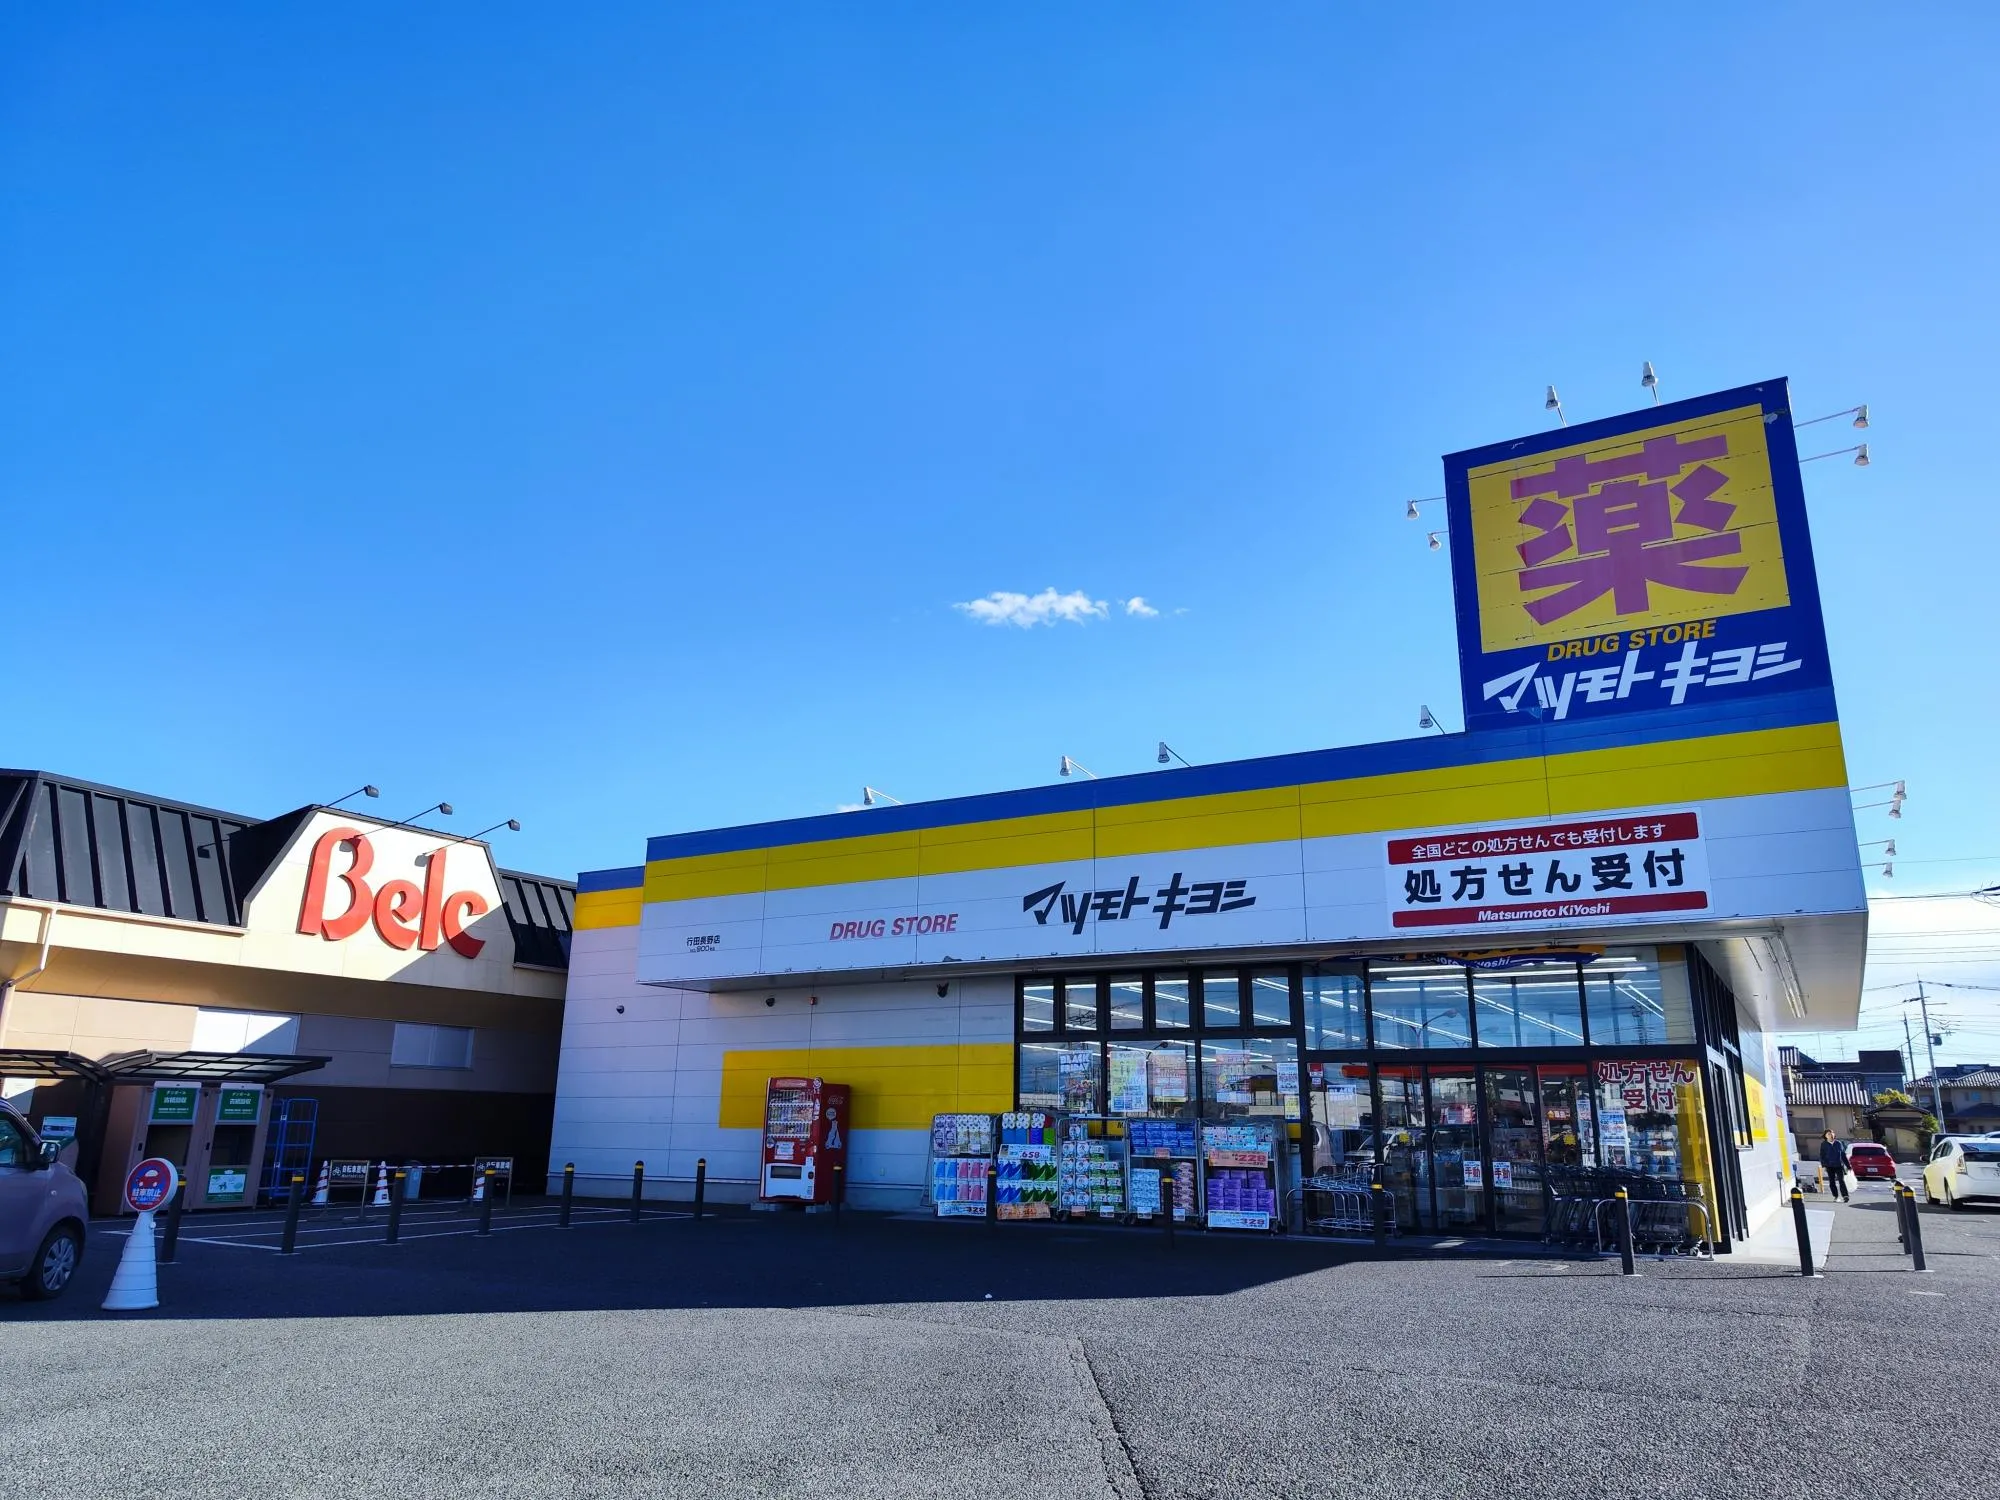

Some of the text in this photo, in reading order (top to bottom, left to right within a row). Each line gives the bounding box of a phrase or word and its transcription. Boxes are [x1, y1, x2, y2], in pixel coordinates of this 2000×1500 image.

[1510, 434, 1749, 626] 薬
[1546, 620, 1718, 662] DRUG STORE
[1482, 640, 1803, 721] マツモトキヨシ
[1411, 823, 1667, 860] 全国どこの処方せんでも受付します
[297, 826, 490, 960] Belc
[1404, 848, 1686, 905] 処方せん受付
[1022, 872, 1258, 935] マツモトキヨシ
[1477, 902, 1611, 922] Matsumoto KiYoshi
[829, 913, 959, 941] DRUG STORE
[1597, 1061, 1696, 1086] 処方せん
[1622, 1087, 1675, 1111] 受付
